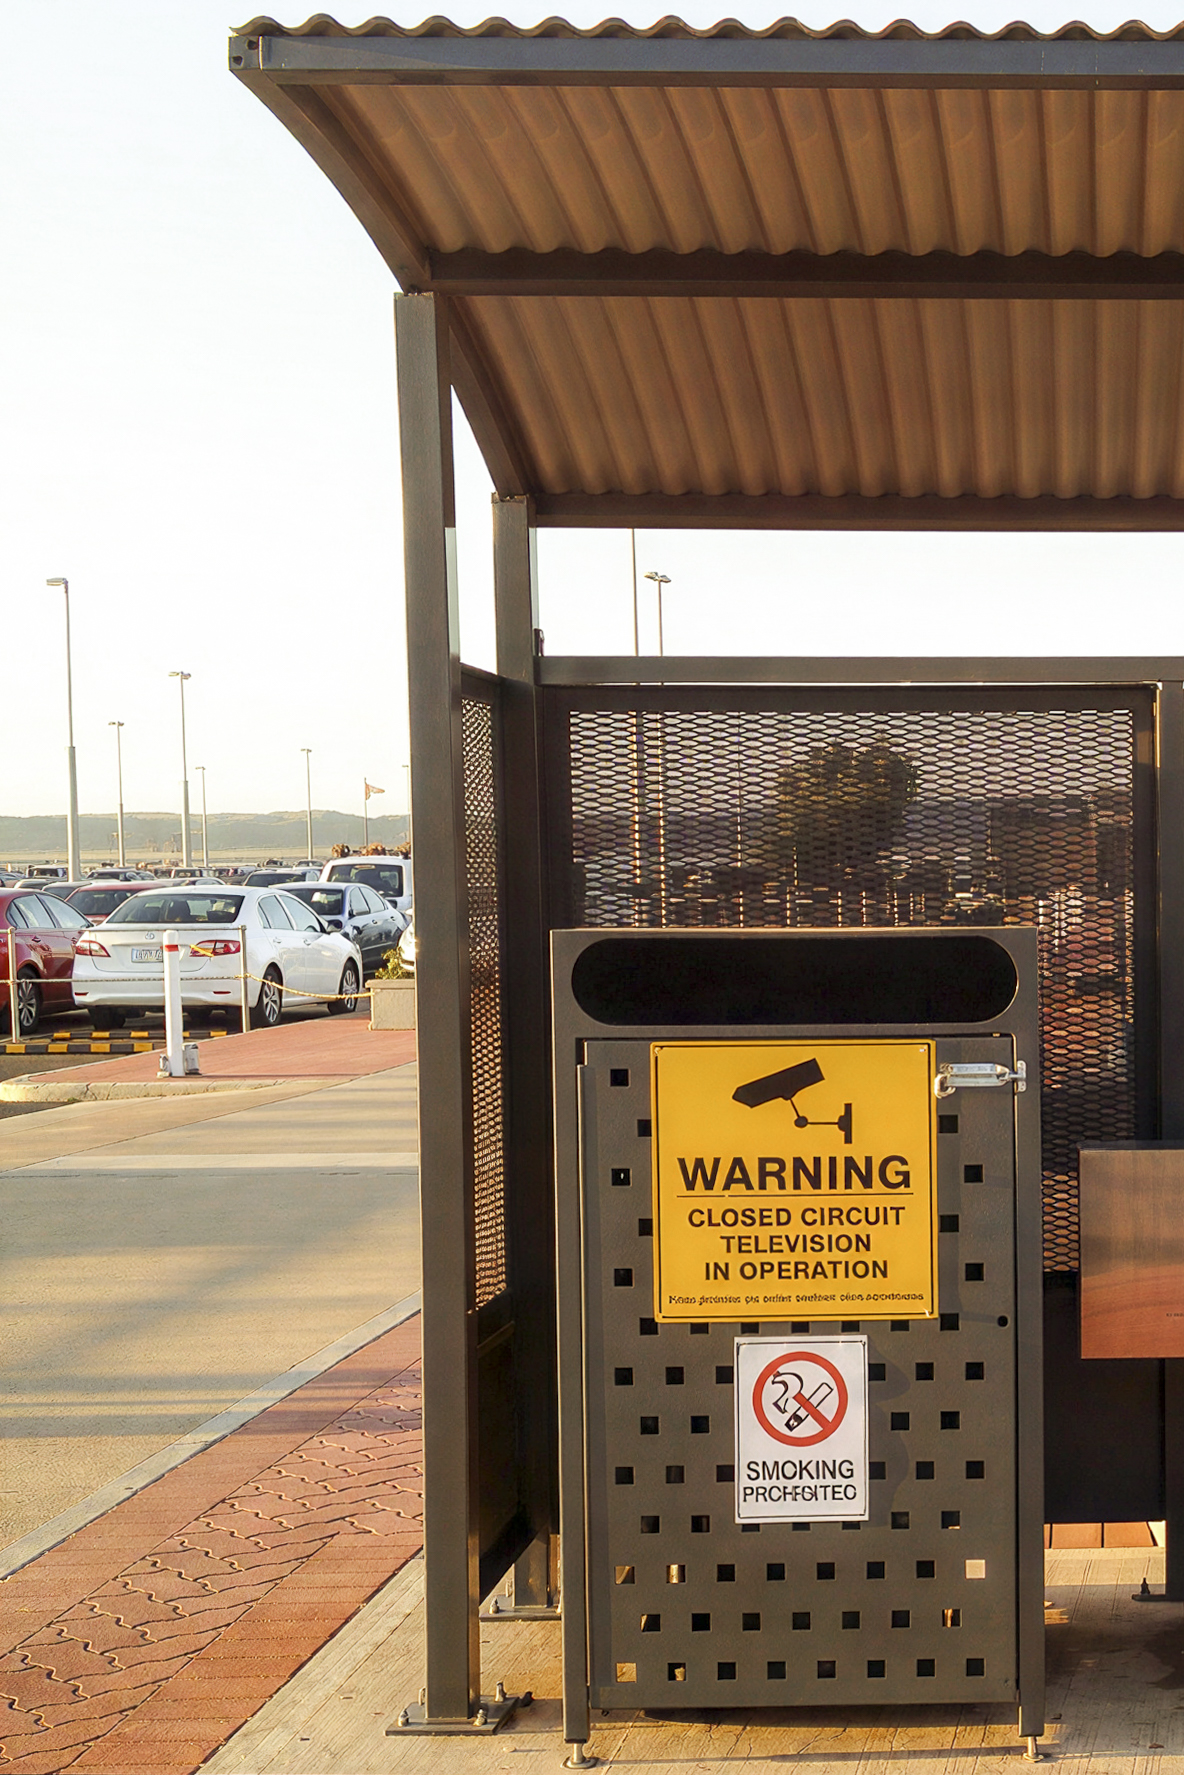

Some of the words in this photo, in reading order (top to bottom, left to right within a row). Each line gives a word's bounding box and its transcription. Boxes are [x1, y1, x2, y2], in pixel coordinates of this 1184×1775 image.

[676, 1154, 912, 1192] WARNING
[687, 1207, 792, 1228] CLOSED
[800, 1206, 906, 1227] CIRCUIT
[719, 1233, 871, 1254] TELEVISION
[705, 1261, 730, 1281] IN
[739, 1259, 888, 1281] OPERATION
[746, 1459, 854, 1481] SMOKING
